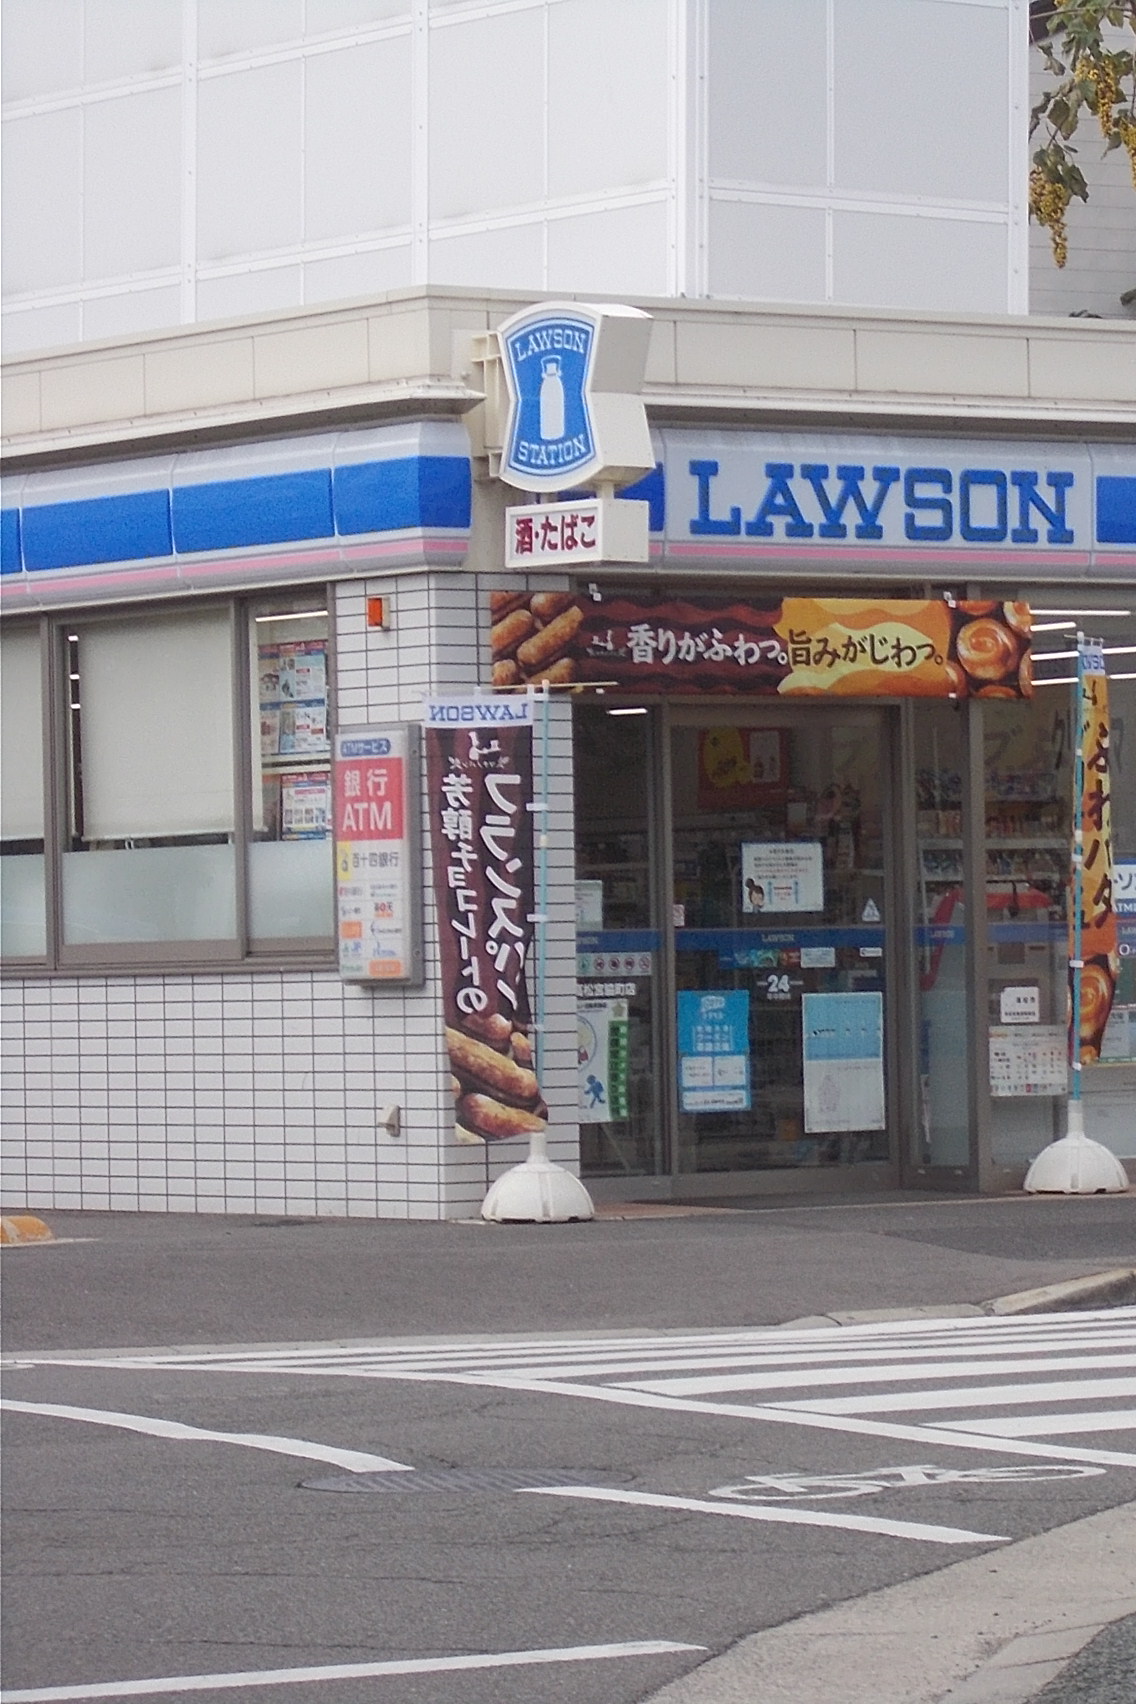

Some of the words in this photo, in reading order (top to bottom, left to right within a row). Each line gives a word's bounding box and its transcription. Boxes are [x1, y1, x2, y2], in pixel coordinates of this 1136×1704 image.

[514, 329, 587, 362] LAWSON
[518, 435, 587, 466] STATION
[688, 459, 1074, 544] LAWSON
[514, 514, 597, 555] 酒・たばこ
[343, 768, 389, 798] 銀行
[342, 800, 393, 832] ATM
[766, 974, 791, 993] 24
